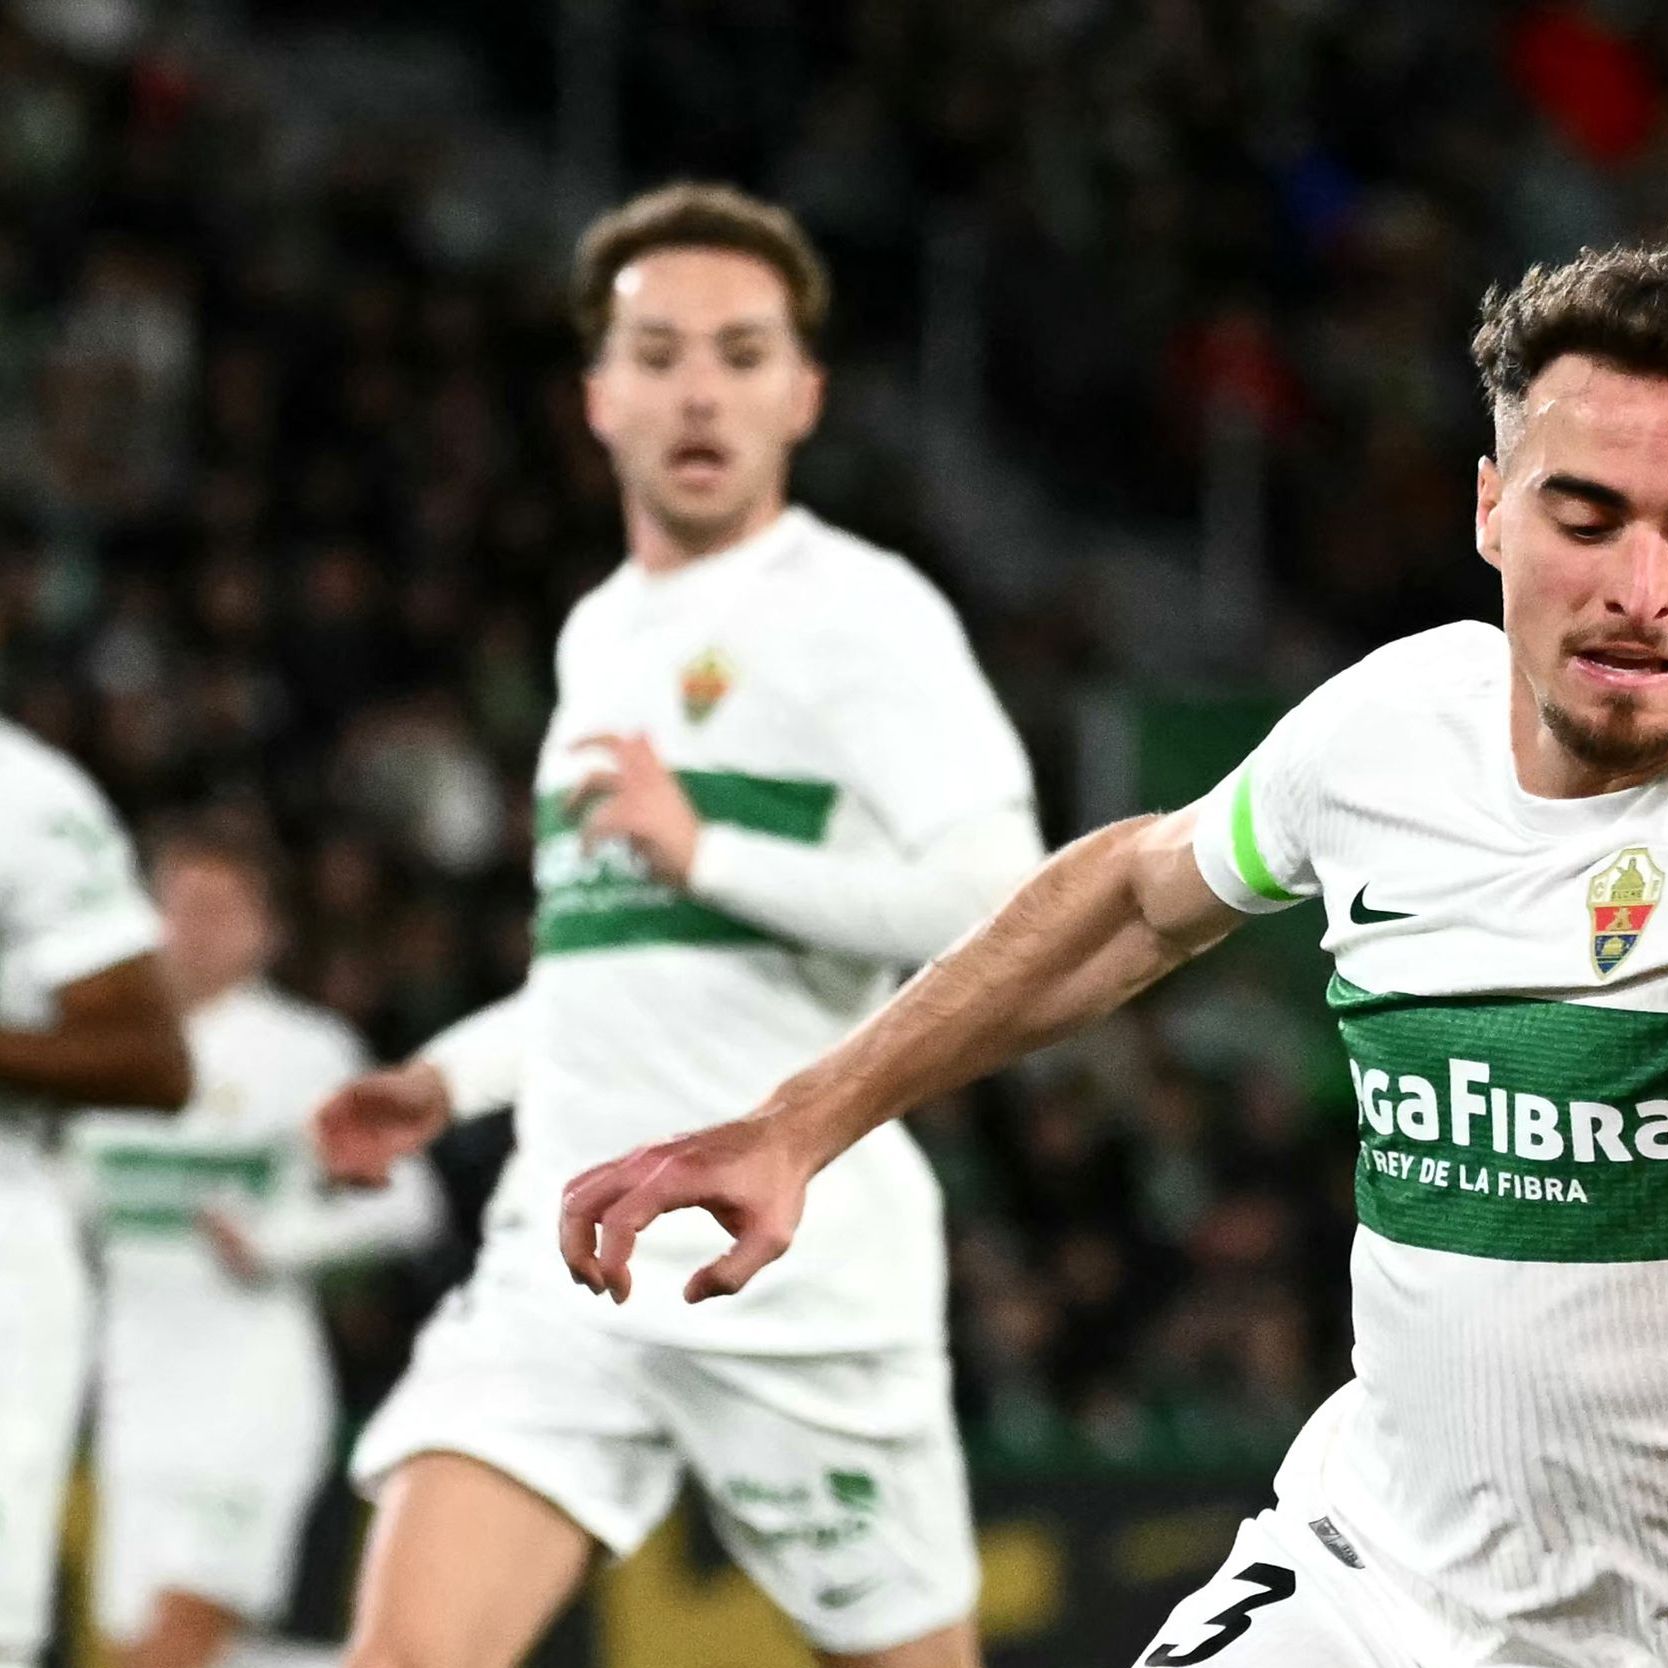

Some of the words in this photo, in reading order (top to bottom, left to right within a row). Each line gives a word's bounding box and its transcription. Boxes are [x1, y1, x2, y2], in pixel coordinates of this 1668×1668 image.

[1372, 1149, 1415, 1180] REY
[1419, 1157, 1451, 1187] DE
[1459, 1164, 1489, 1194] LA
[1498, 1171, 1588, 1203] FIBRA
[1145, 1562, 1296, 1667] 3
